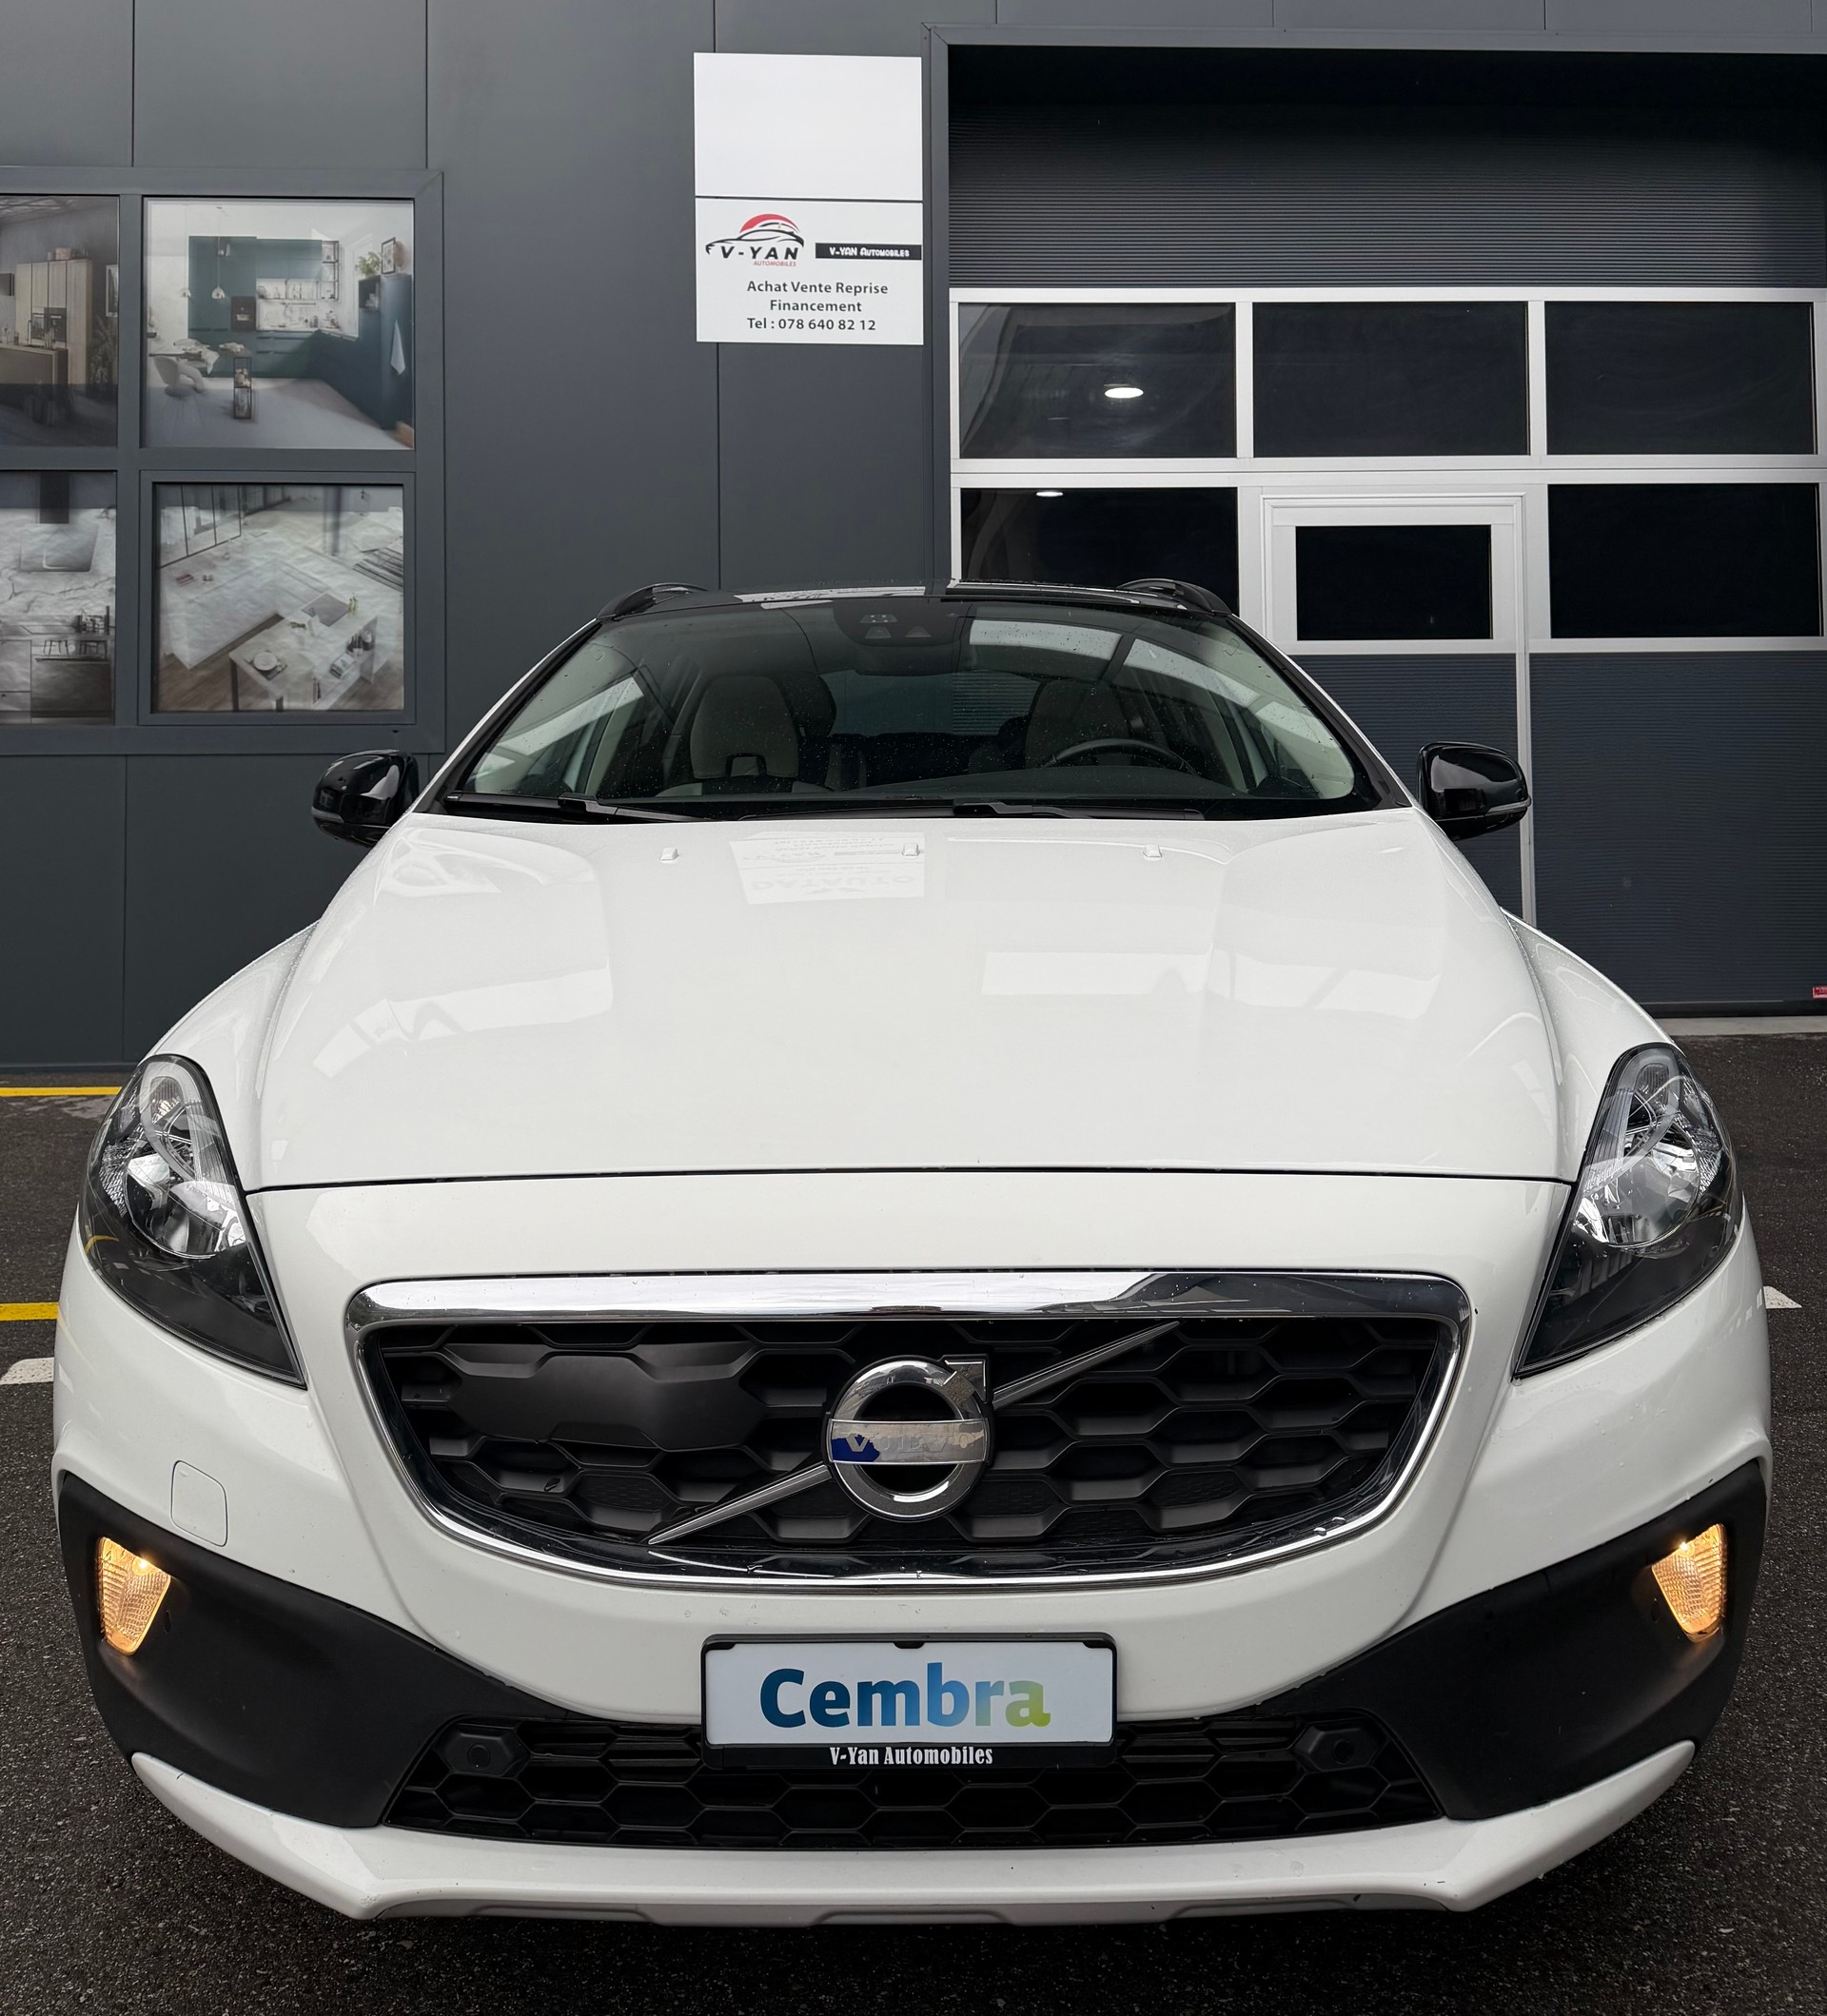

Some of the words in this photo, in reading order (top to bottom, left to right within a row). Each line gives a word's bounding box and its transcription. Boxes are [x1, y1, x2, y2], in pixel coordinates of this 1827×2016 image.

[720, 245, 798, 260] V-YAN
[829, 246, 858, 257] V-YAN
[747, 280, 788, 292] Achat
[791, 281, 832, 293] Vente
[835, 282, 889, 297] Reprise
[770, 299, 862, 312] Financement
[777, 318, 805, 330] 078
[808, 319, 835, 330] 640
[837, 319, 855, 330] 82
[859, 320, 876, 331] 12
[759, 1661, 1051, 1729] Cembra
[829, 1747, 879, 1766] V-Yan
[883, 1746, 994, 1766] Automobiles
